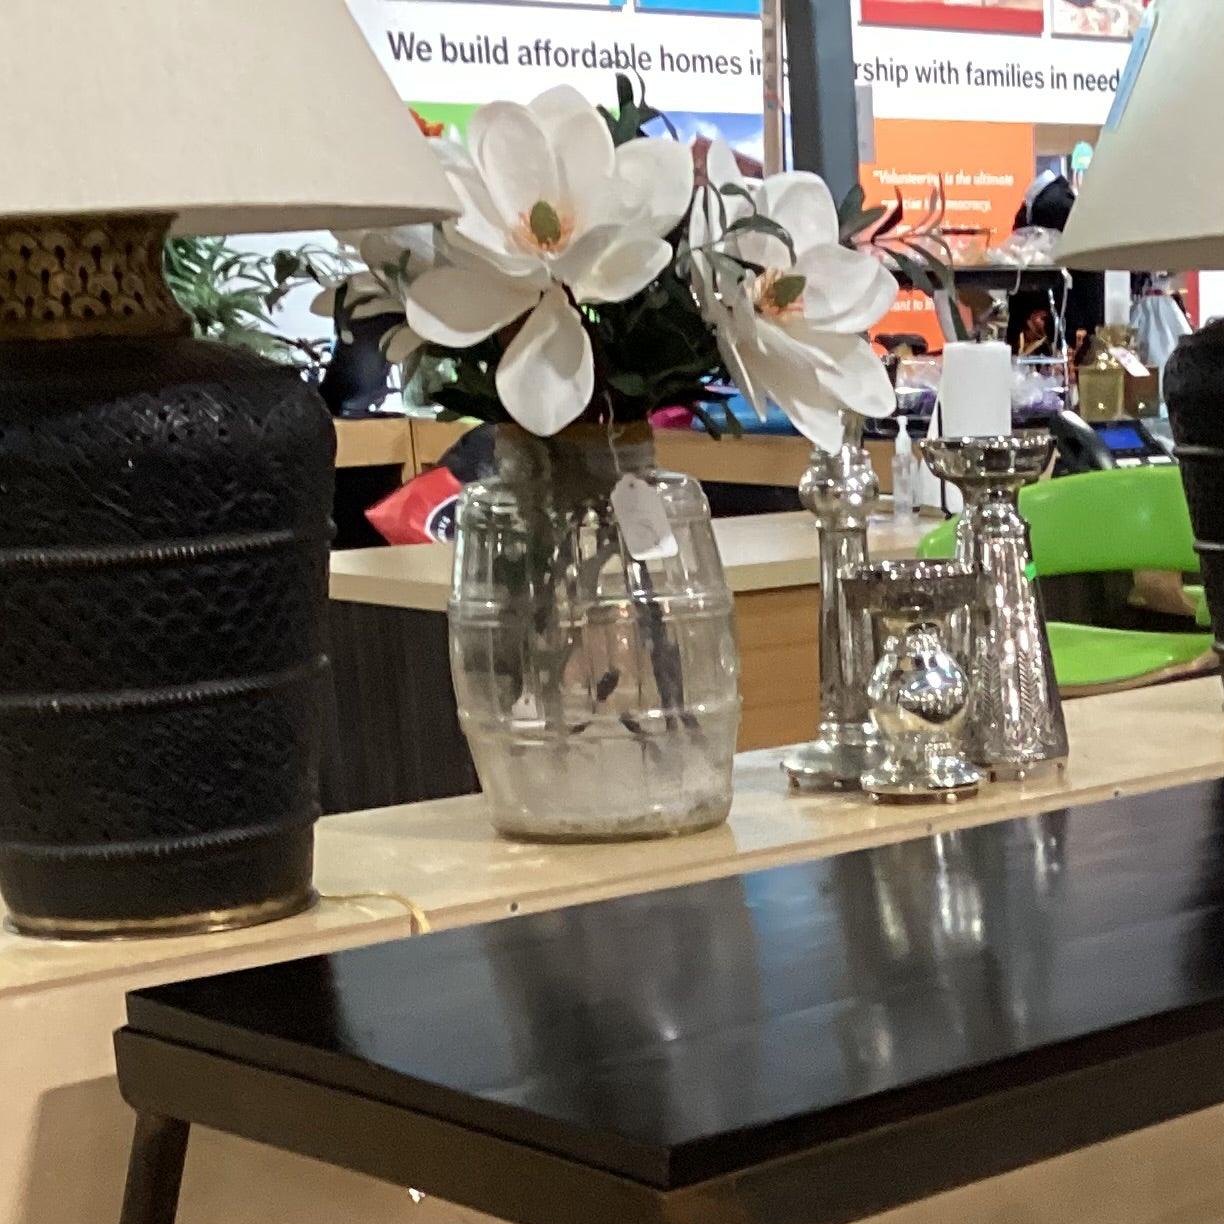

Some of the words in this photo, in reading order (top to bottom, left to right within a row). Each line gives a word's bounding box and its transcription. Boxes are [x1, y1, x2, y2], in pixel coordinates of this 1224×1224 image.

[386, 31, 432, 62] We
[440, 33, 509, 65] build
[517, 39, 651, 70] affordable
[659, 45, 742, 75] homes
[914, 61, 959, 86] with
[966, 62, 1045, 90] families
[1050, 69, 1068, 90] in
[1073, 68, 1121, 92] need
